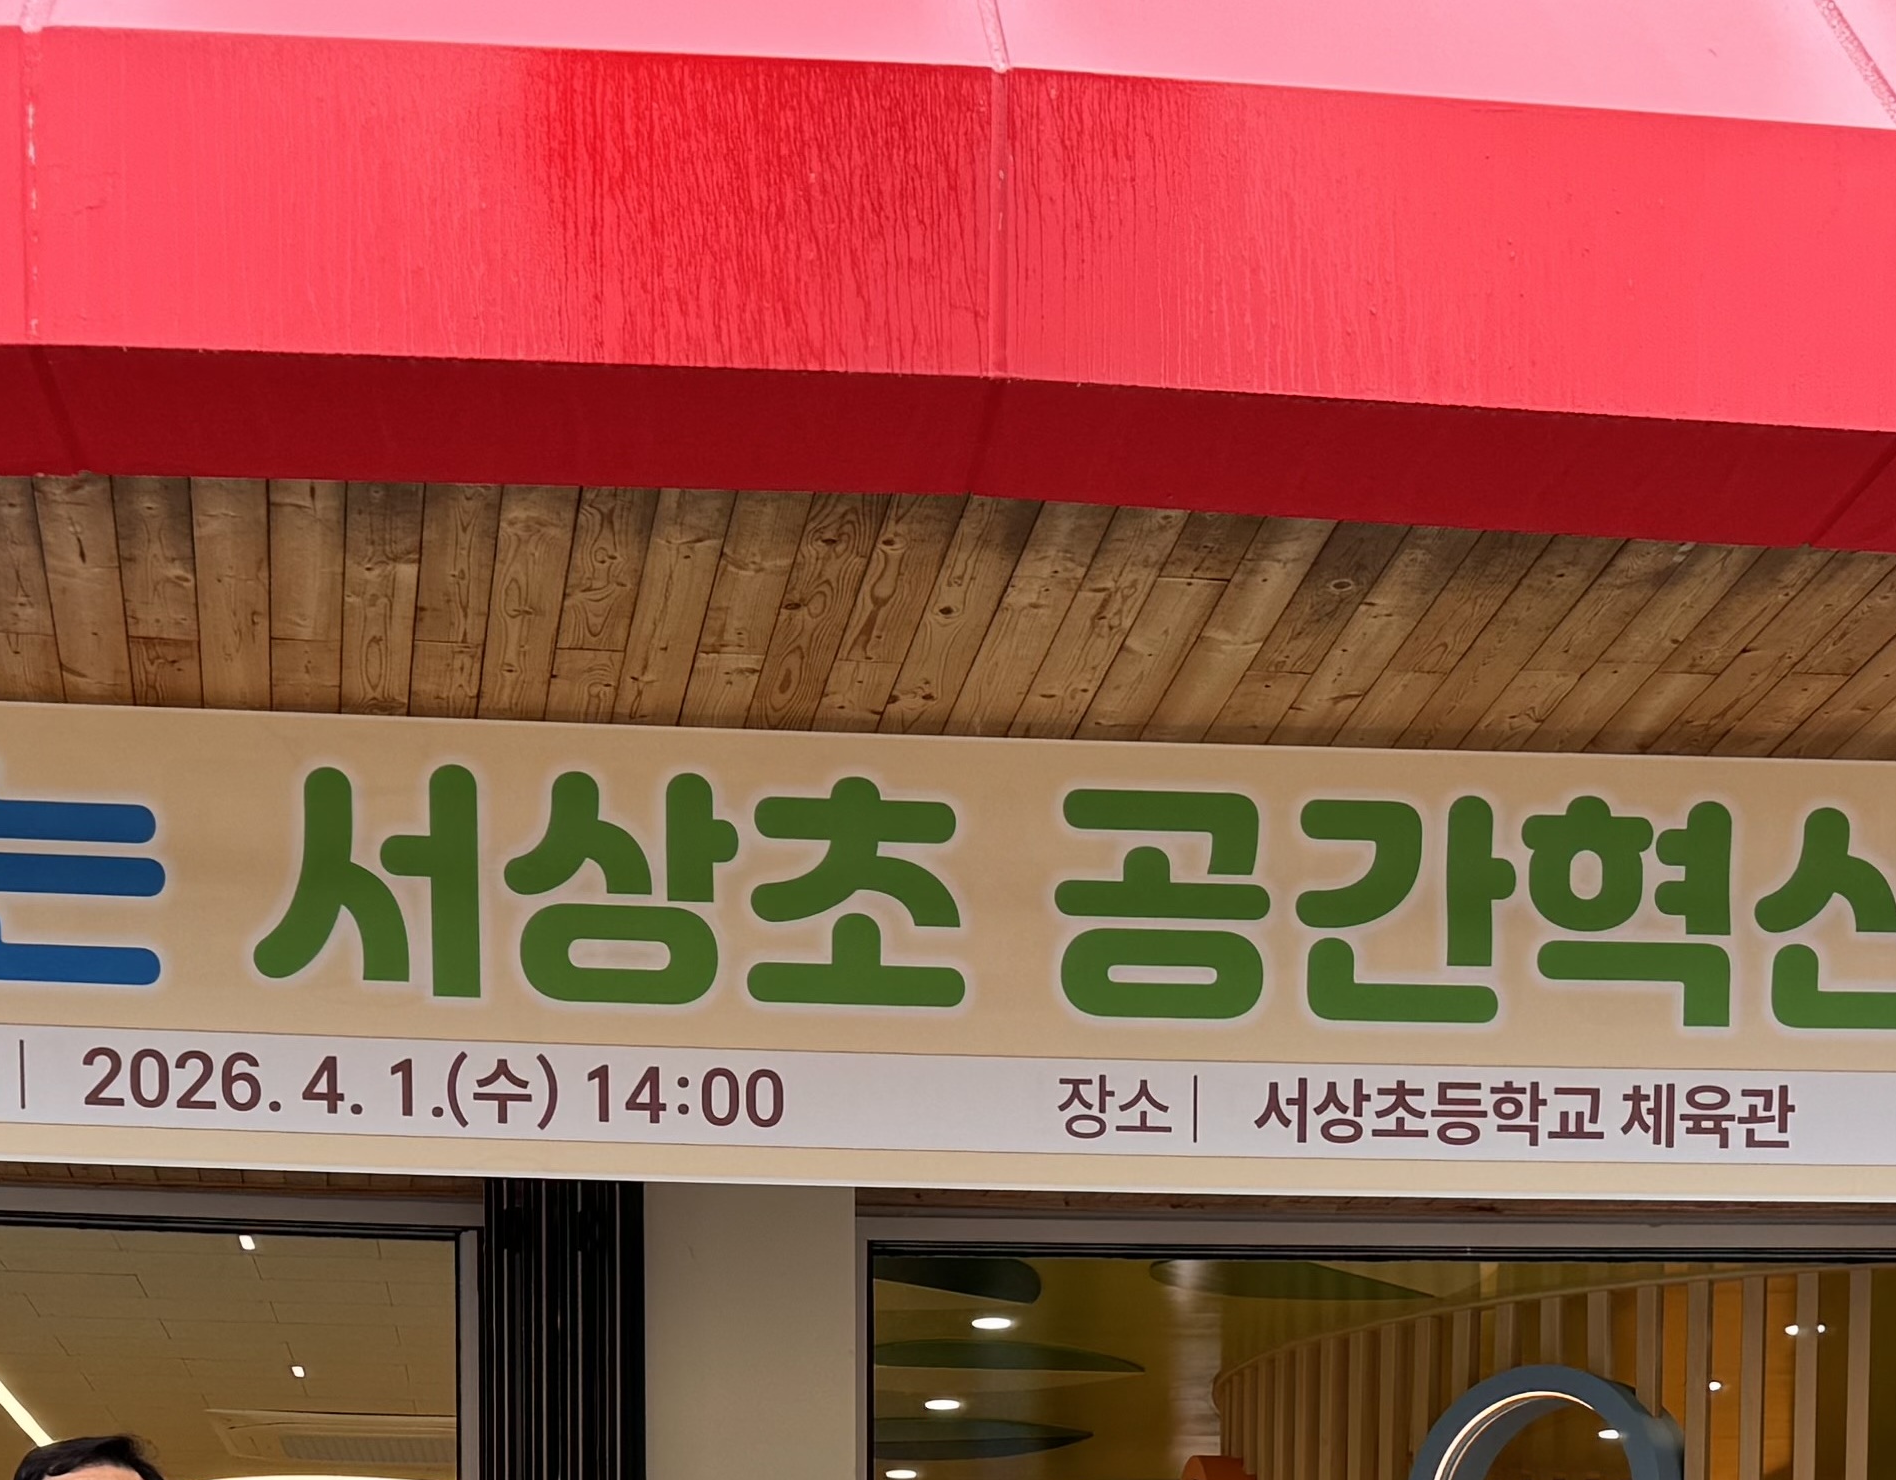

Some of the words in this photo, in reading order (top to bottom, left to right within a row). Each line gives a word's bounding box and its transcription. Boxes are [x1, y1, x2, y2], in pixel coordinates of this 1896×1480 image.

[253, 764, 966, 1007] 서상초
[82, 1047, 282, 1112] 2026.
[302, 1056, 363, 1115] 4.
[390, 1051, 558, 1130] 1.(수)
[587, 1065, 784, 1127] 14:00
[1057, 1075, 1172, 1139] 장소
[1254, 1077, 1604, 1147] 서상초등학교
[1620, 1083, 1796, 1149] 체육관
